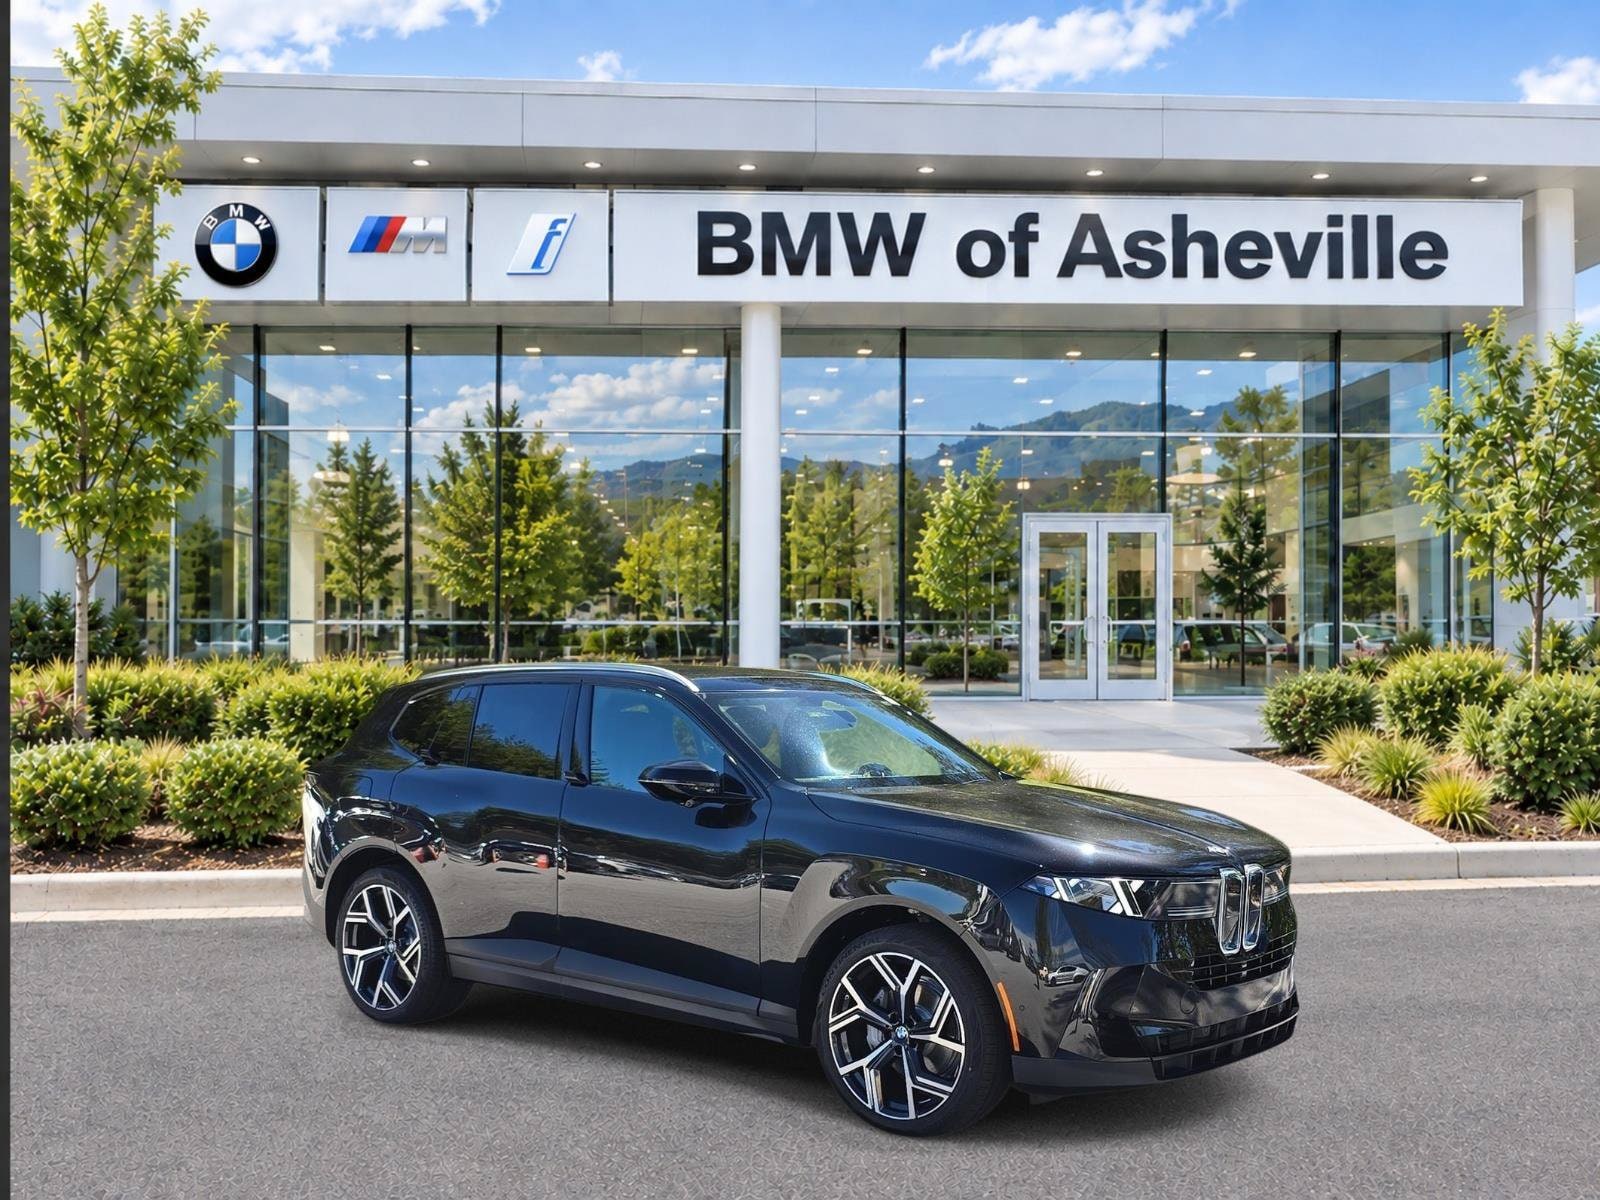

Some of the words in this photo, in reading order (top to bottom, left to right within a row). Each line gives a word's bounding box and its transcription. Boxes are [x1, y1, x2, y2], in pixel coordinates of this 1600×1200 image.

[202, 204, 271, 231] BMW
[697, 210, 927, 277] BMW
[956, 212, 1040, 280] of
[1056, 212, 1450, 281] Asheville
